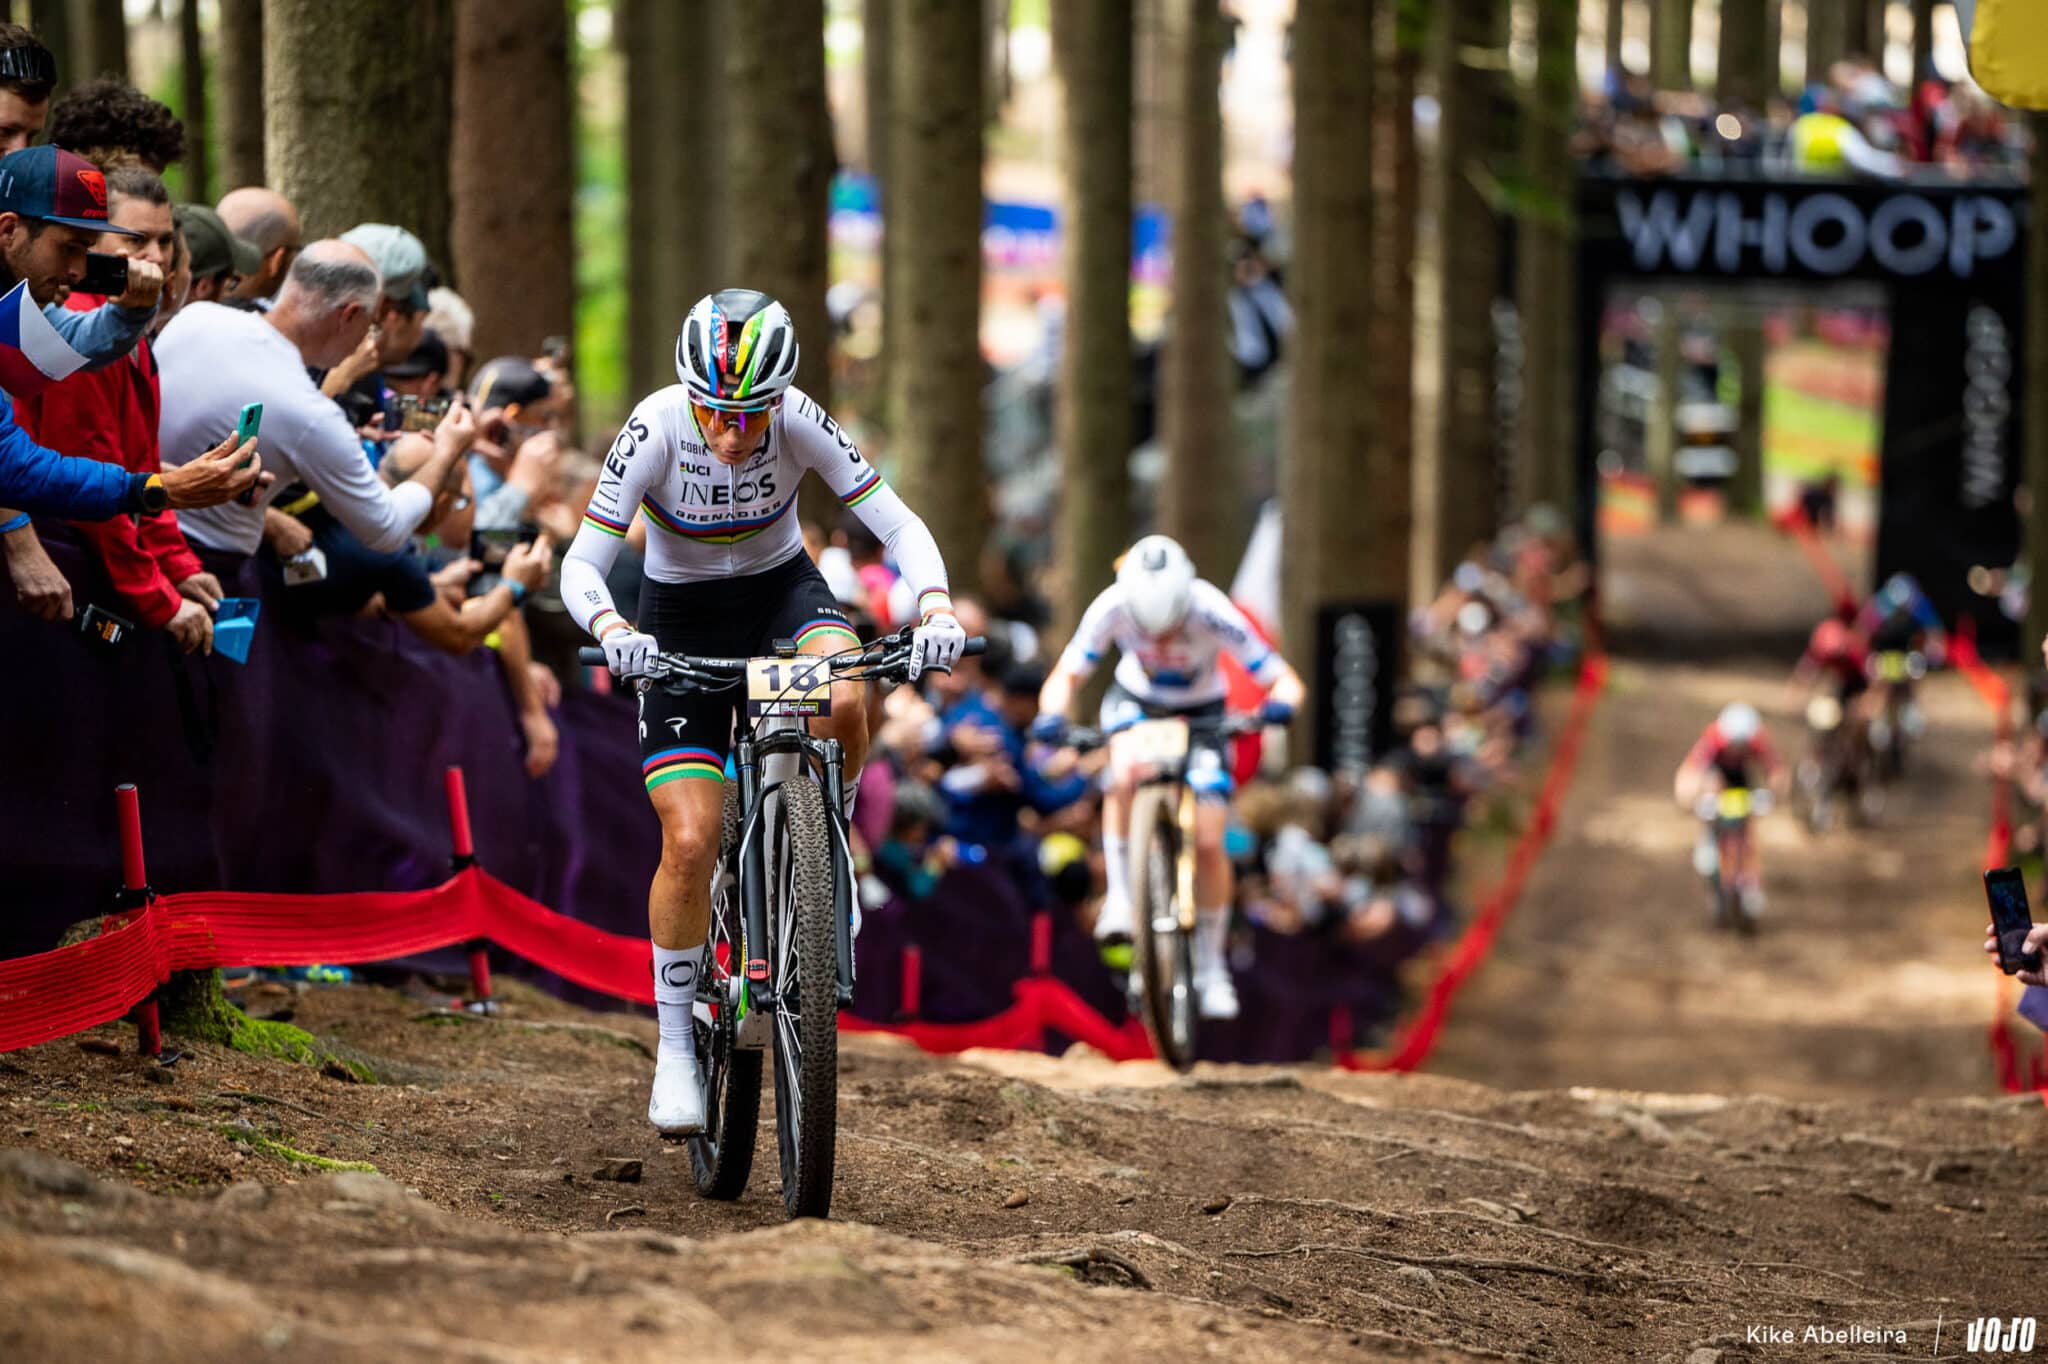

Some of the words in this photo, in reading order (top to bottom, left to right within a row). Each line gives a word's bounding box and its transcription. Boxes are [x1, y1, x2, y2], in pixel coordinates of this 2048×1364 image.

[1616, 191, 2016, 277] WHOOP
[798, 396, 861, 463] INEOS
[599, 416, 649, 504] INEOS
[681, 439, 708, 457] GOBIK
[686, 462, 711, 476] UCI
[680, 472, 776, 506] INEOS
[675, 501, 781, 521] GRENADIER
[701, 658, 736, 668] MOST
[761, 663, 819, 692] 18
